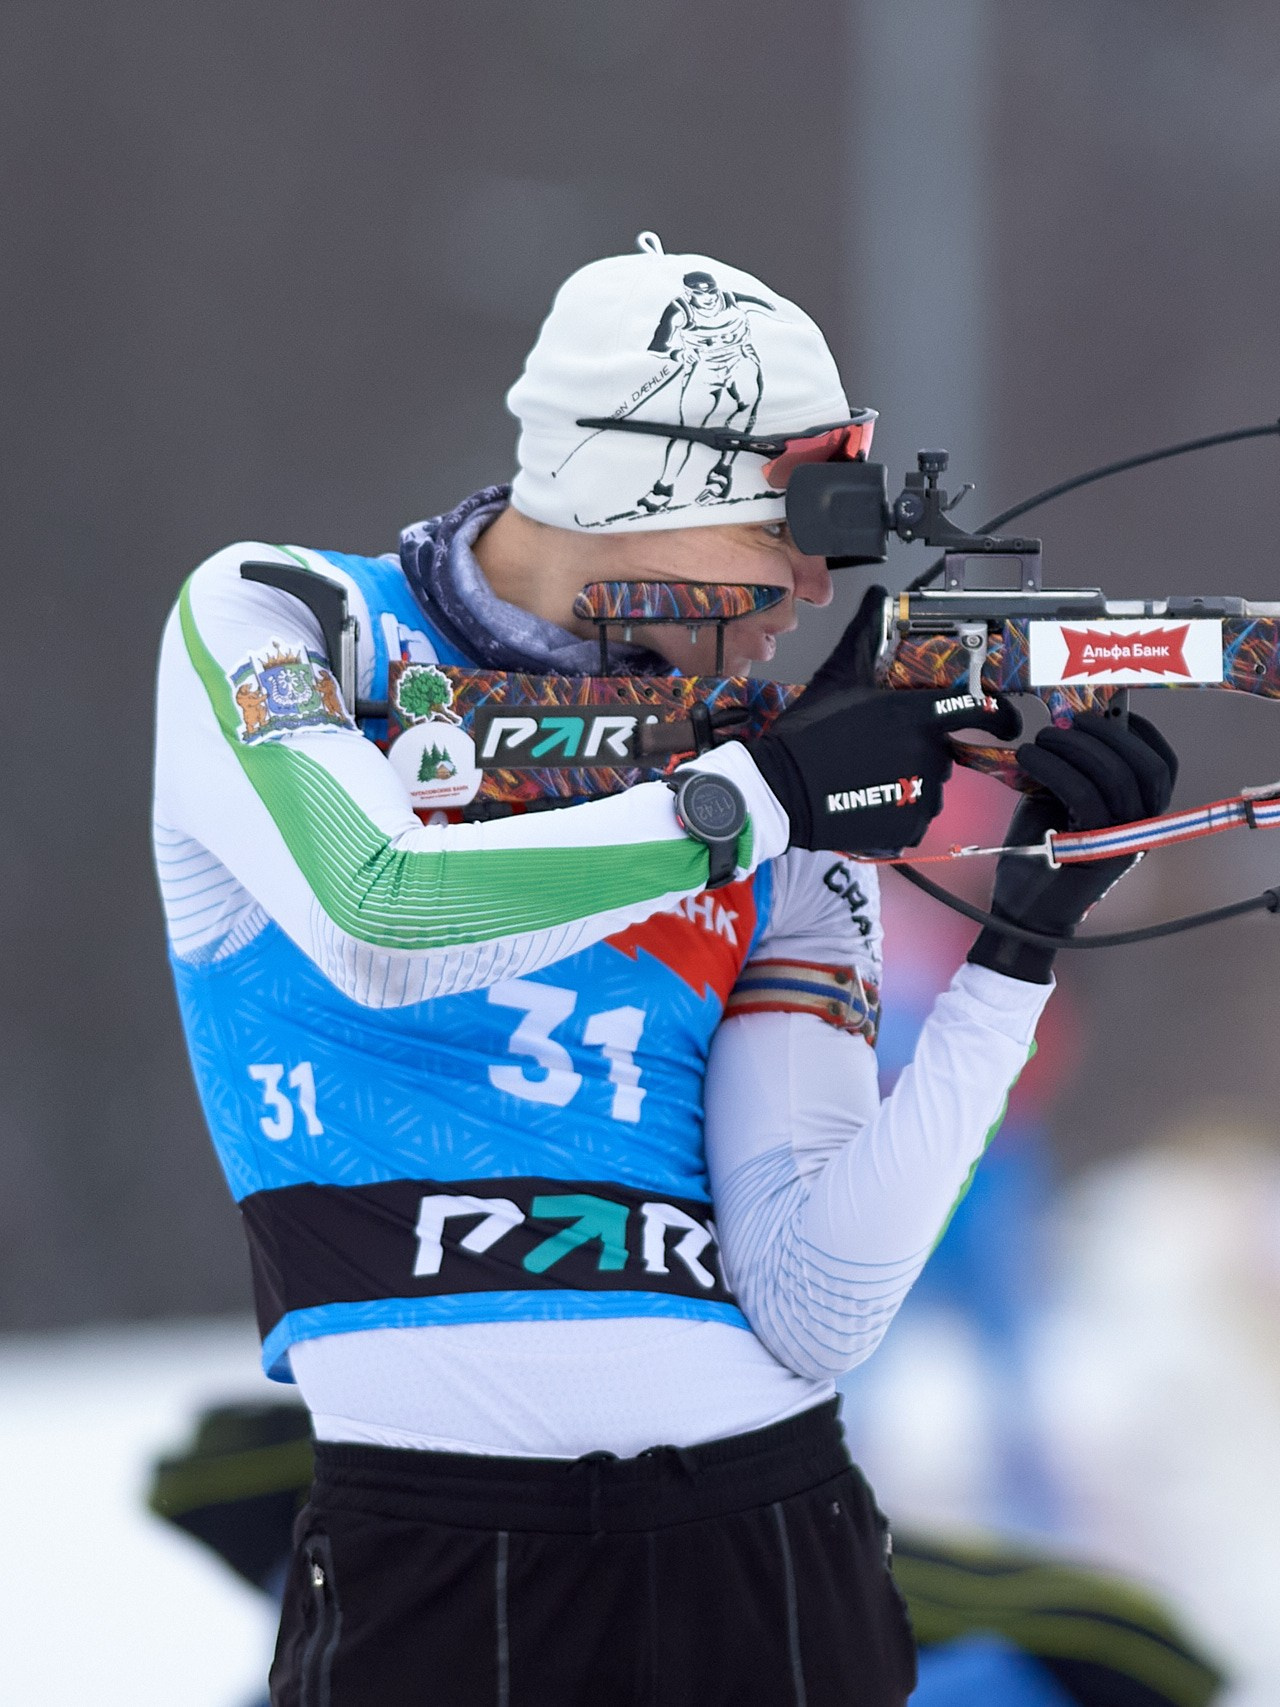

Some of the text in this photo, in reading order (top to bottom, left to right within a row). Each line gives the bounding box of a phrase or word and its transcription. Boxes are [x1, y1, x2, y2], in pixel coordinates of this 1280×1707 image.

[1082, 643, 1170, 662] Альфа Банк
[488, 979, 647, 1124] 31
[248, 1061, 325, 1142] 31
